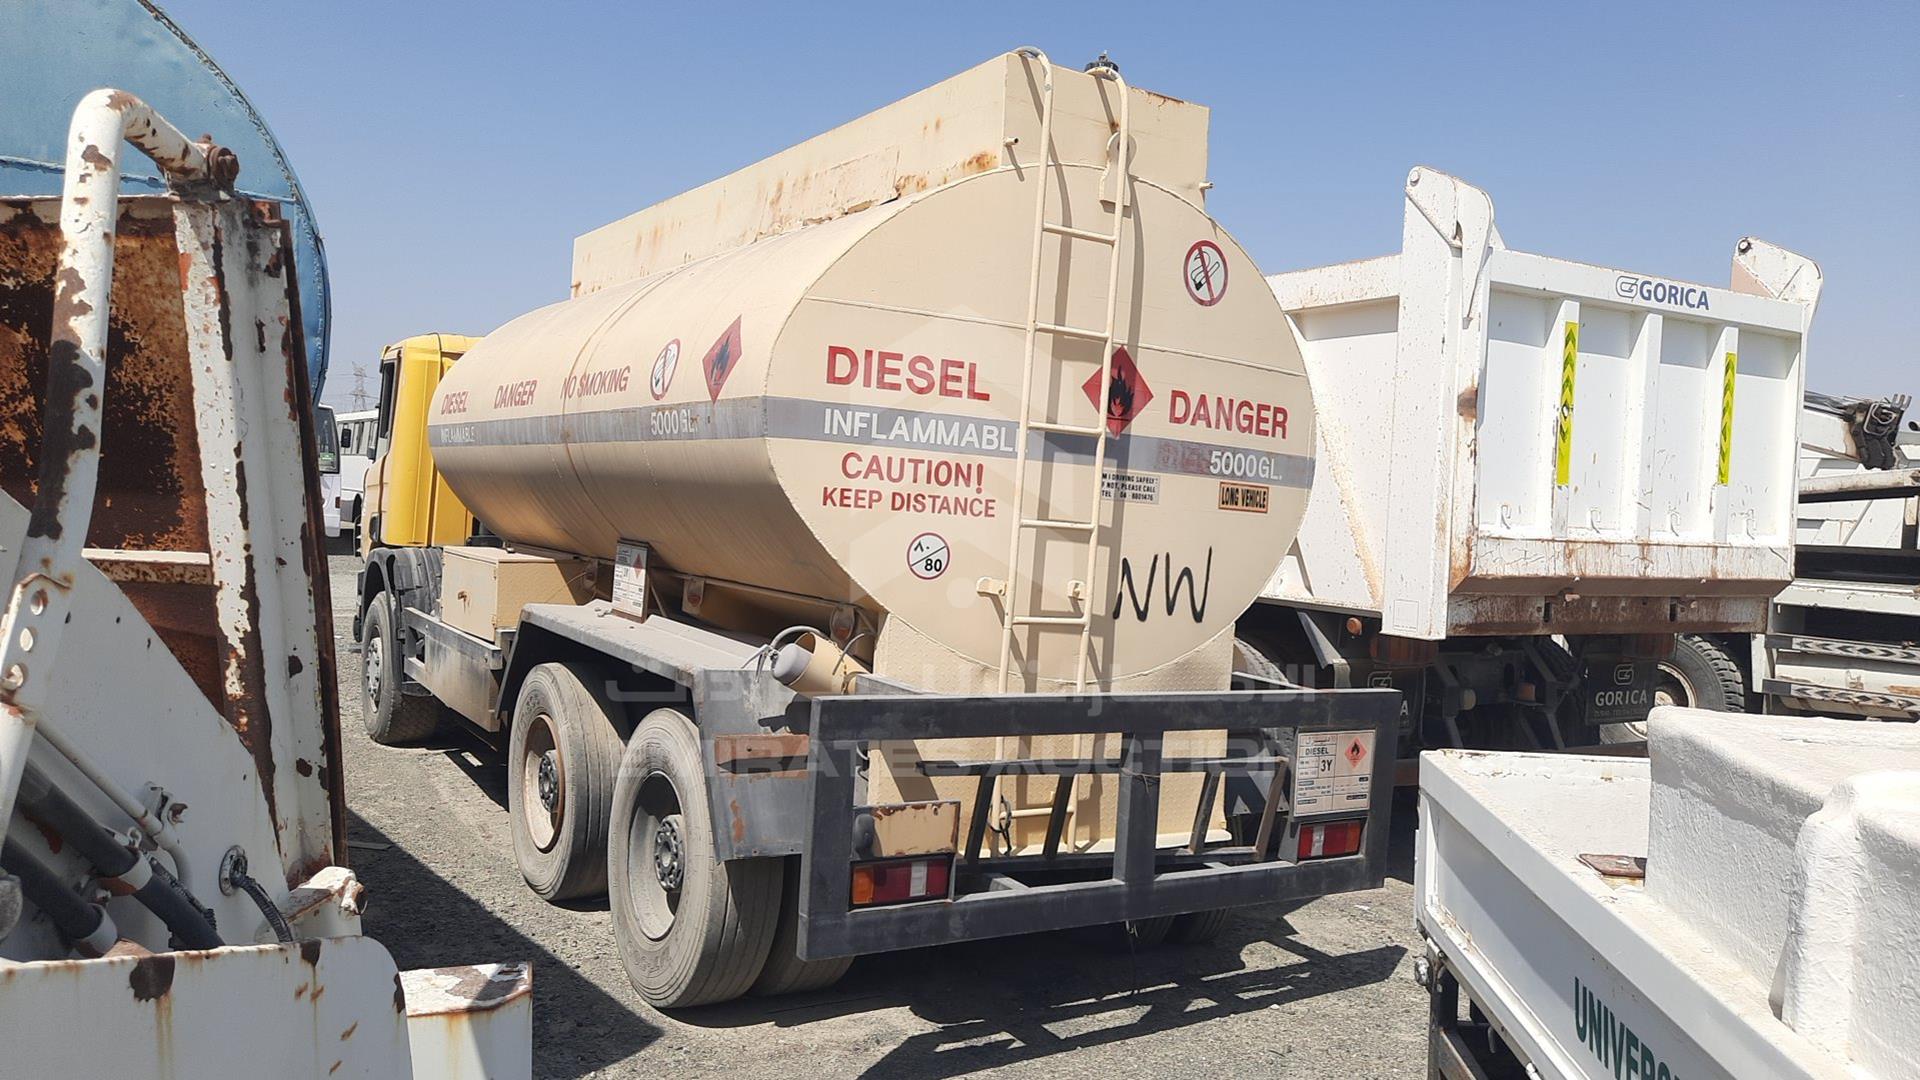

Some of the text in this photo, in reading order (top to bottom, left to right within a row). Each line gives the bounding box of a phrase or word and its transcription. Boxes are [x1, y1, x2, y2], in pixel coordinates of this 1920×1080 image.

[1639, 280, 1710, 310] GORICA
[560, 365, 631, 399] NO SMOKING
[826, 345, 990, 402] DIESEL
[441, 391, 469, 415] DIESEL
[494, 379, 538, 409] DANGER
[1169, 389, 1289, 439] DANGER
[841, 451, 985, 494] CAUTION!
[1121, 483, 1142, 491] PLEASE
[1143, 485, 1156, 493] CALL
[1221, 487, 1267, 509] LONG VEHICLE
[822, 487, 996, 518] KEEP DISTANCE
[924, 558, 943, 573] 80
[1595, 690, 1648, 706] GORICA
[1305, 747, 1329, 755] DIESEL
[1320, 759, 1333, 772] 3Y
